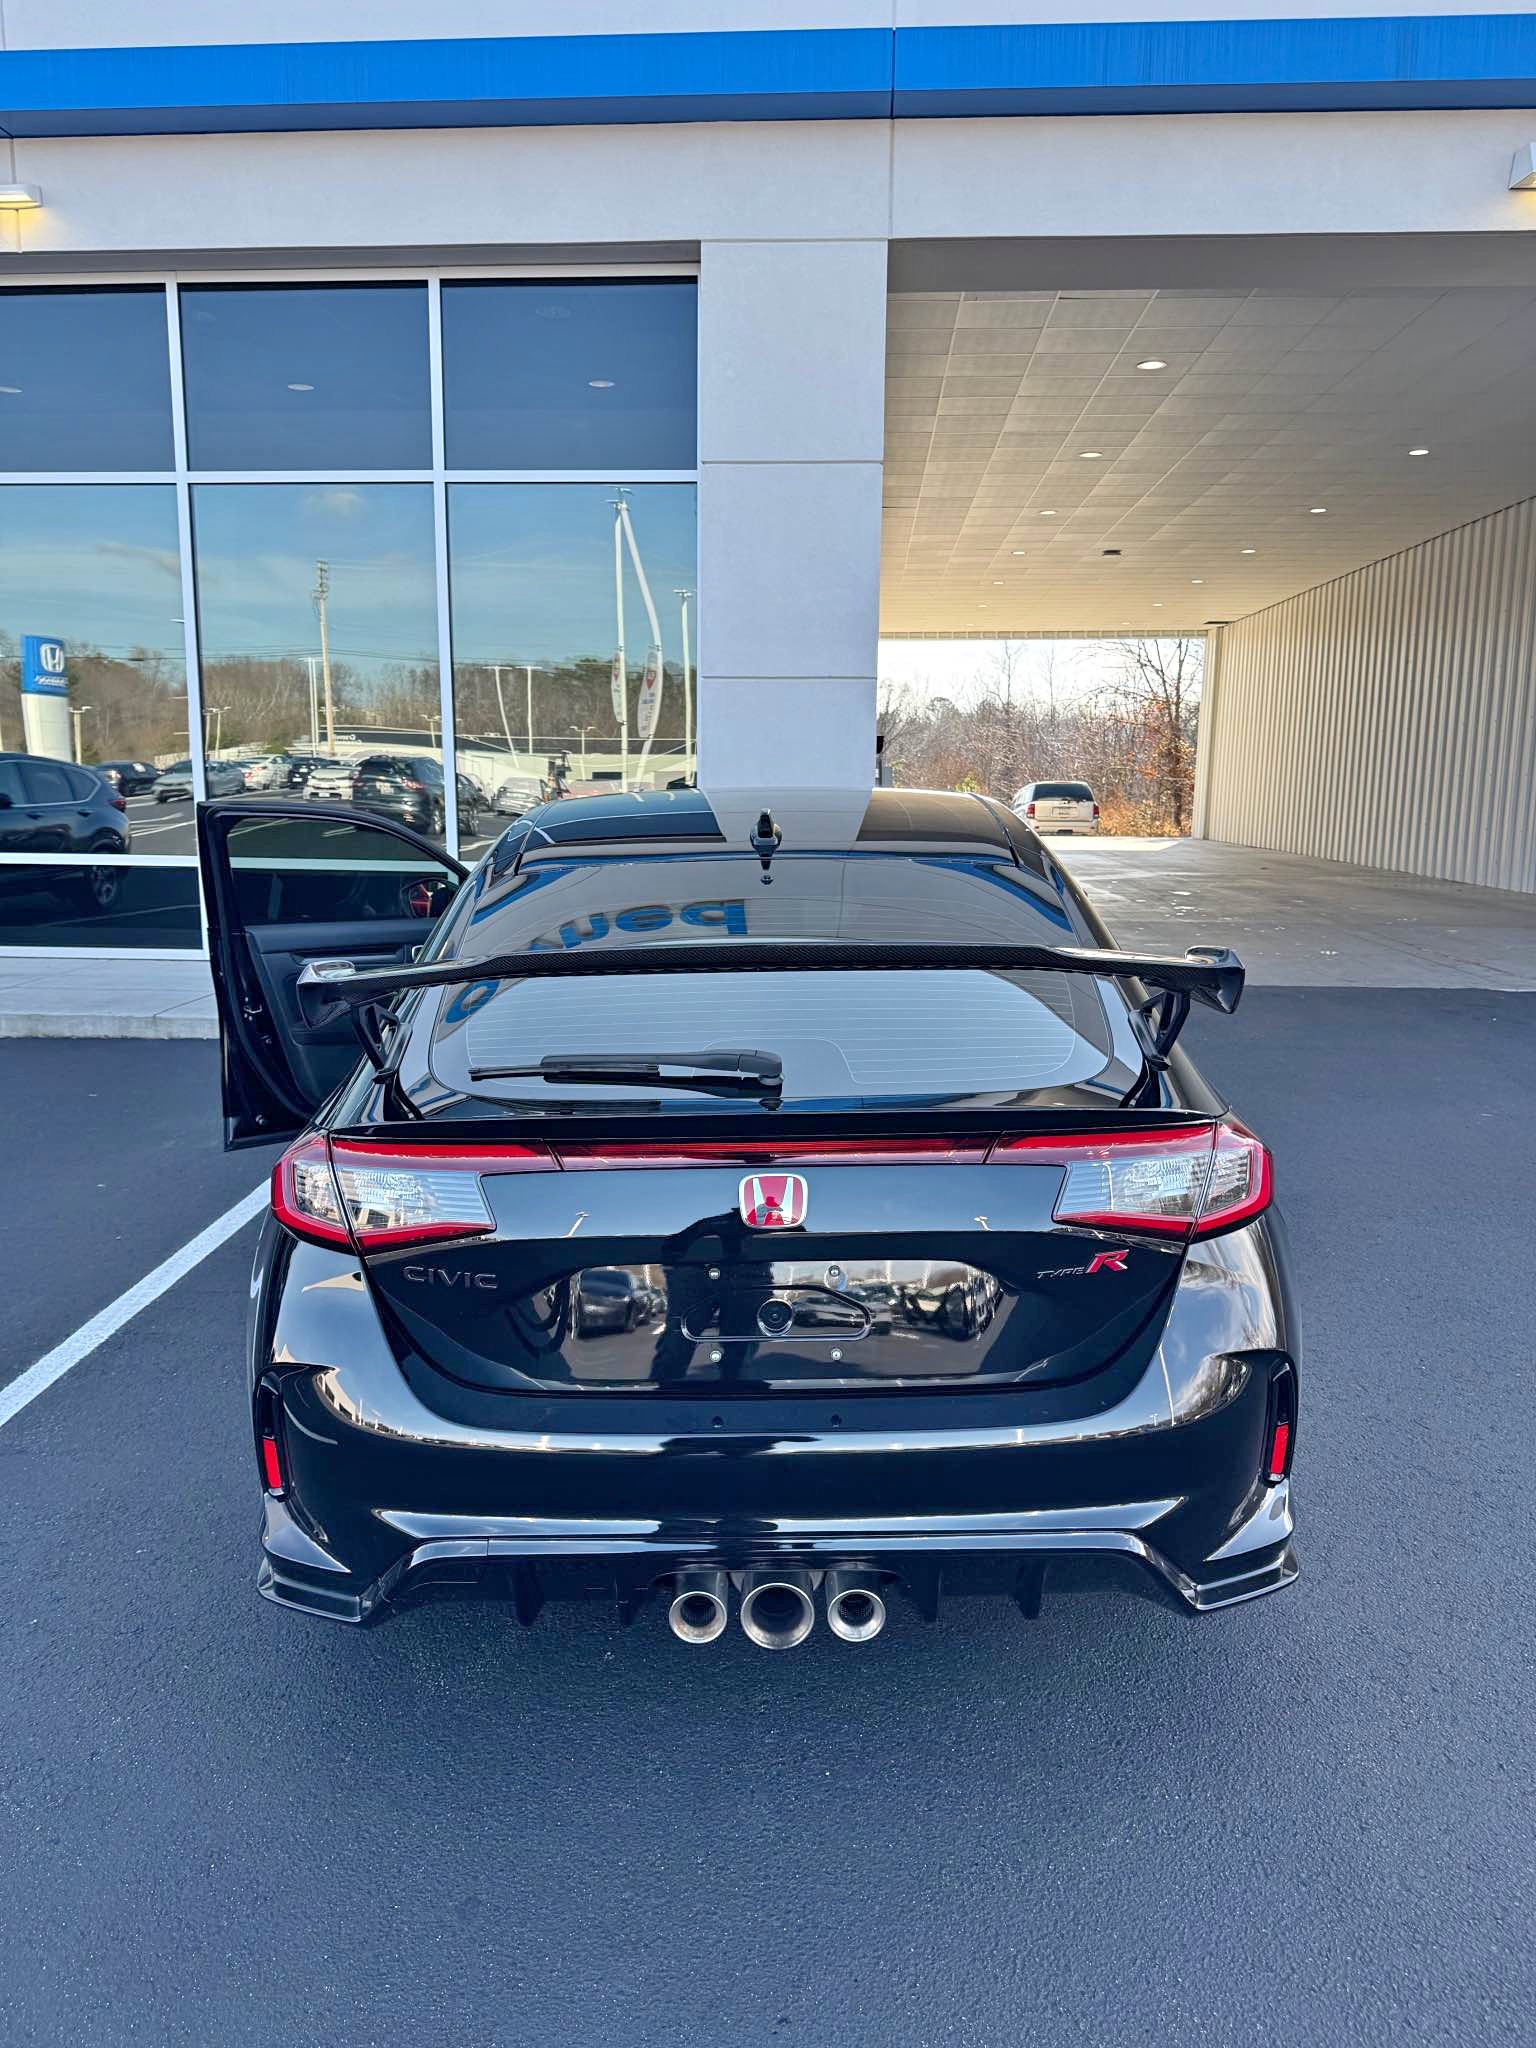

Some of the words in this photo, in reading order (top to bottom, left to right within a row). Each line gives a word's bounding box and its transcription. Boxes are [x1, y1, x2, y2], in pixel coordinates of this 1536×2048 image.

[402, 1265, 498, 1289] CIVIC
[1036, 1266, 1085, 1279] TYPE
[1085, 1248, 1130, 1275] R
